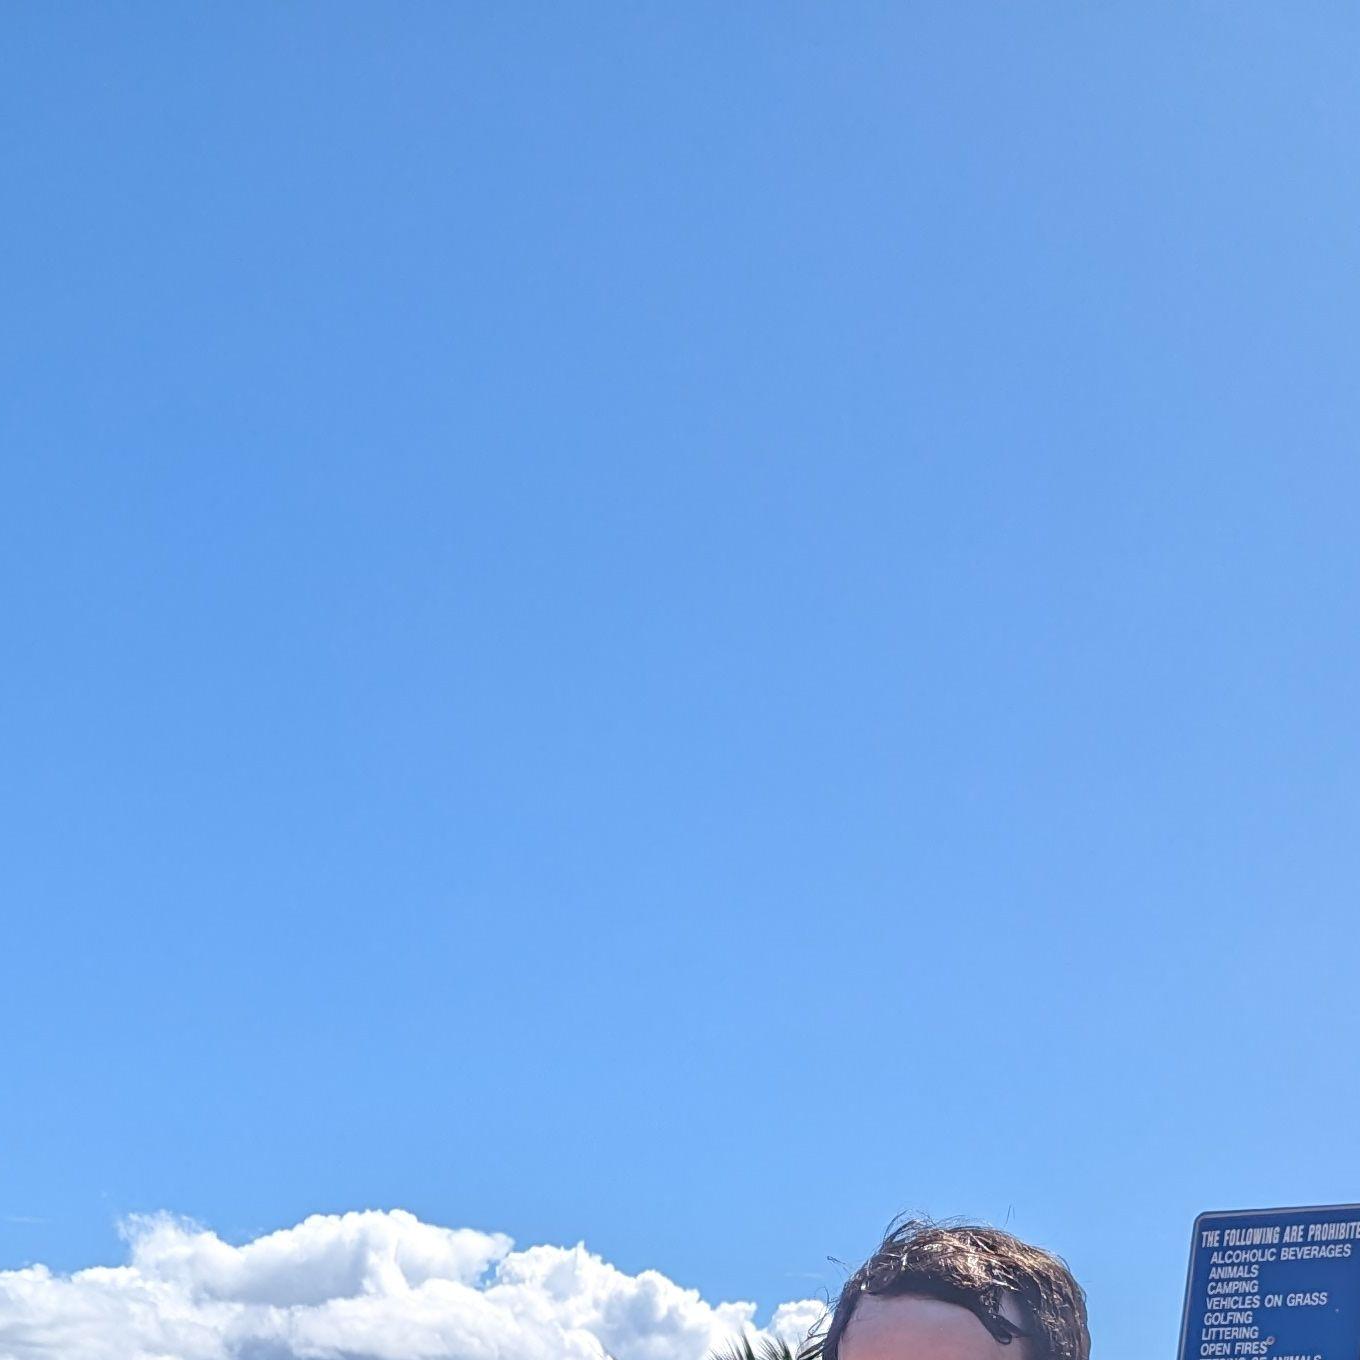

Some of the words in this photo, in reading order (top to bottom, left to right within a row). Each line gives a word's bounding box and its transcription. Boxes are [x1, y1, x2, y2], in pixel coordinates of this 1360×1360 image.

[1202, 1231, 1220, 1247] THE
[1224, 1227, 1280, 1246] FOLLOWING
[1282, 1224, 1305, 1242] ARE
[1211, 1250, 1277, 1264] ALCOHOLIC
[1280, 1244, 1352, 1261] BEVERAGES
[1209, 1265, 1258, 1279] ANIMALS
[1208, 1280, 1258, 1295] CAMPING
[1206, 1296, 1260, 1310] VEHICLES
[1264, 1294, 1282, 1307] ON
[1287, 1292, 1328, 1306] GRASS
[1204, 1312, 1252, 1325] GOLFING
[1202, 1327, 1258, 1340] LITTERING
[1200, 1343, 1230, 1356] OPEN
[1234, 1341, 1268, 1355] FIRES
